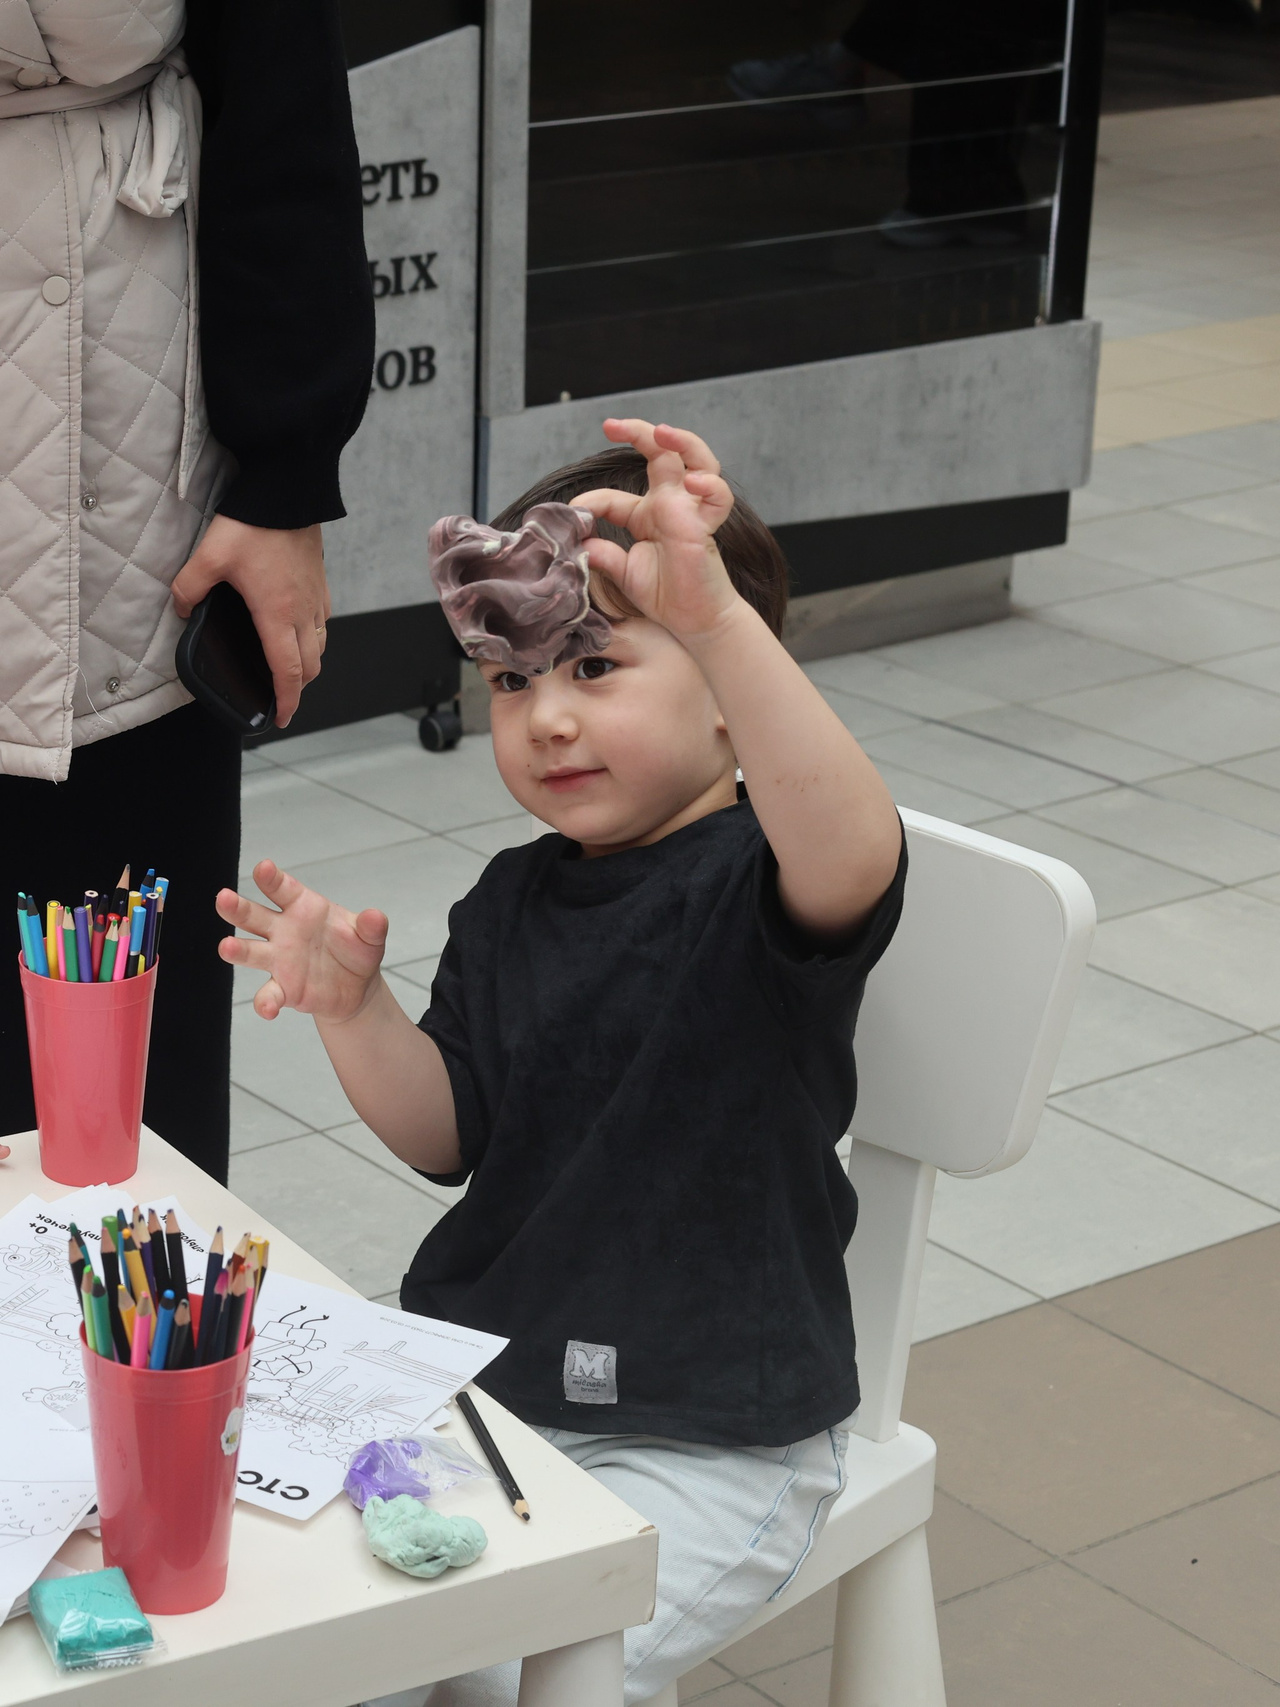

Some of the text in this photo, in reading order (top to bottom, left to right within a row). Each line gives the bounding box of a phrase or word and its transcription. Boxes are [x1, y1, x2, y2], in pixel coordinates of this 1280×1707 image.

[360, 158, 439, 206] еть
[368, 252, 438, 299] ых
[371, 345, 437, 392] ов
[29, 1222, 48, 1235] 0+
[569, 1348, 609, 1380] M
